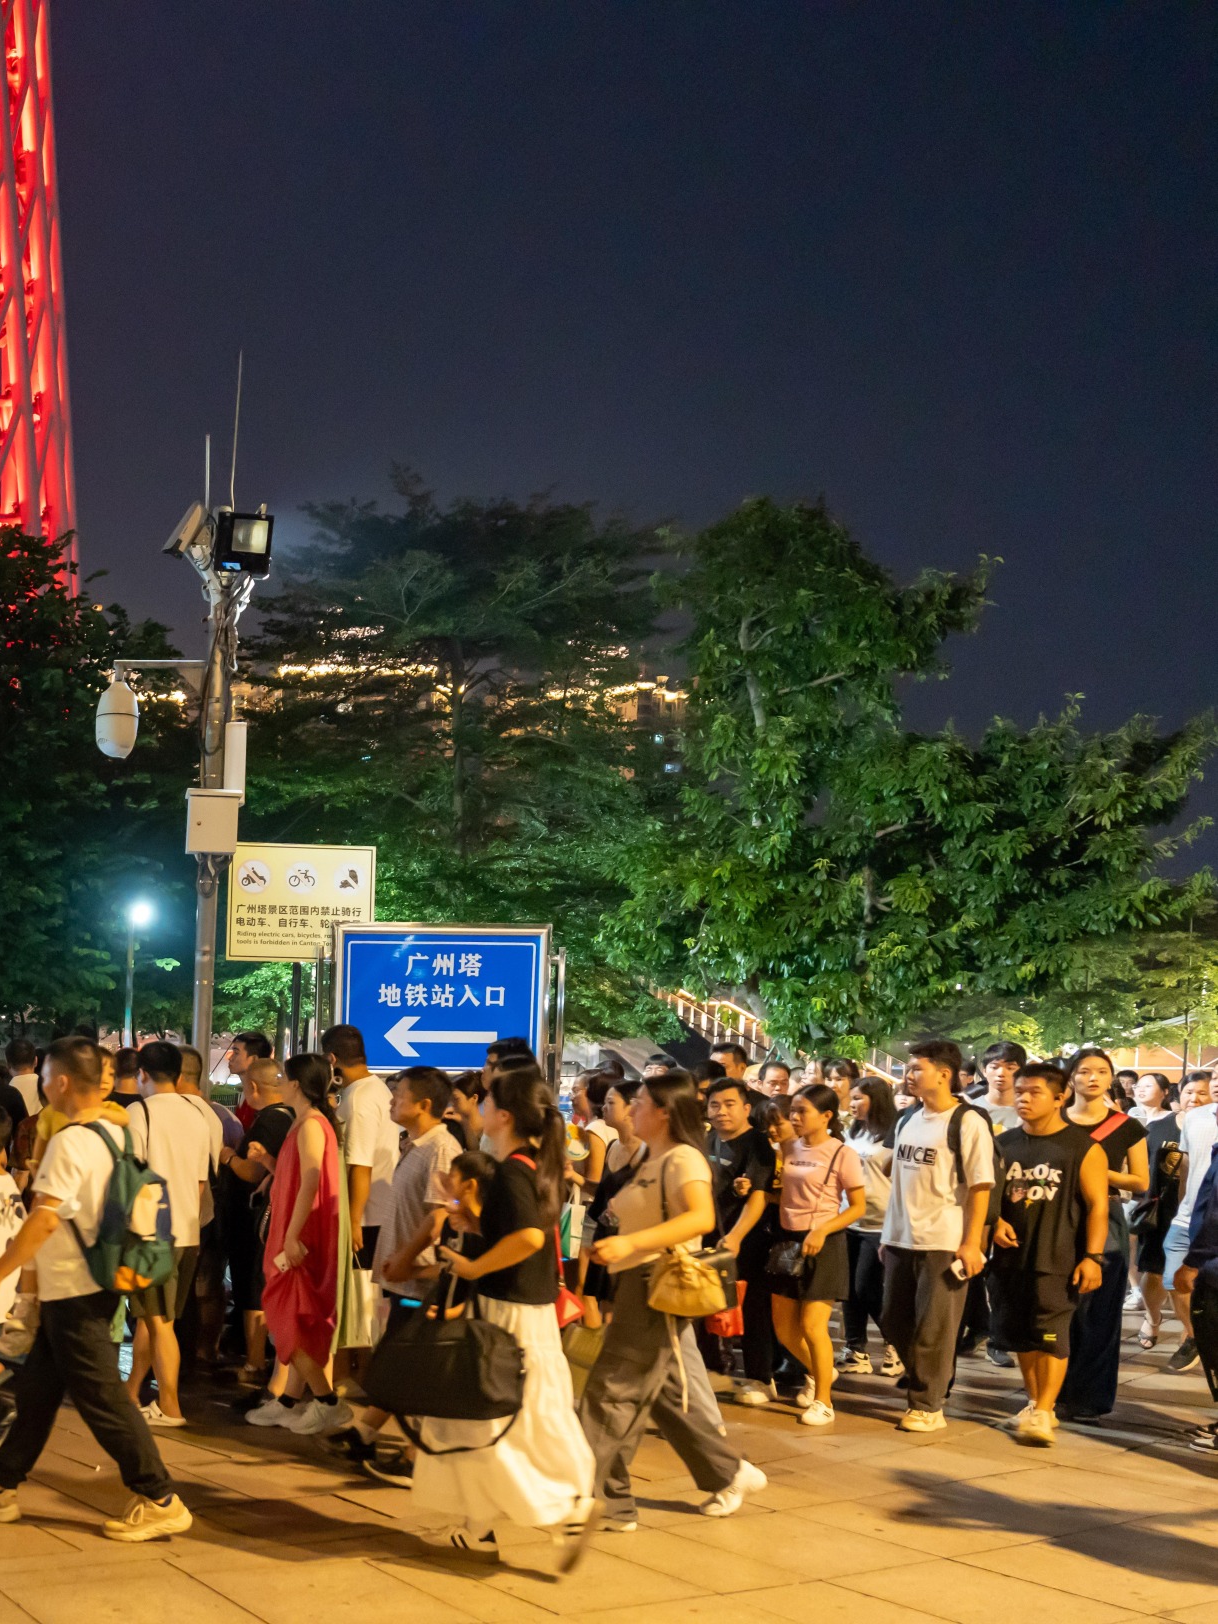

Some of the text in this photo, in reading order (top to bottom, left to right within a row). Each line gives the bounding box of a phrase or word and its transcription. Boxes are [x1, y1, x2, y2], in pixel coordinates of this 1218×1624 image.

[236, 904, 362, 917] 广州塔景区范围内禁止骑行
[235, 917, 360, 929] 电动车、自行车、轮
[405, 952, 483, 977] 广州塔
[378, 983, 505, 1008] 地铁站入口
[896, 1144, 938, 1166] NICE
